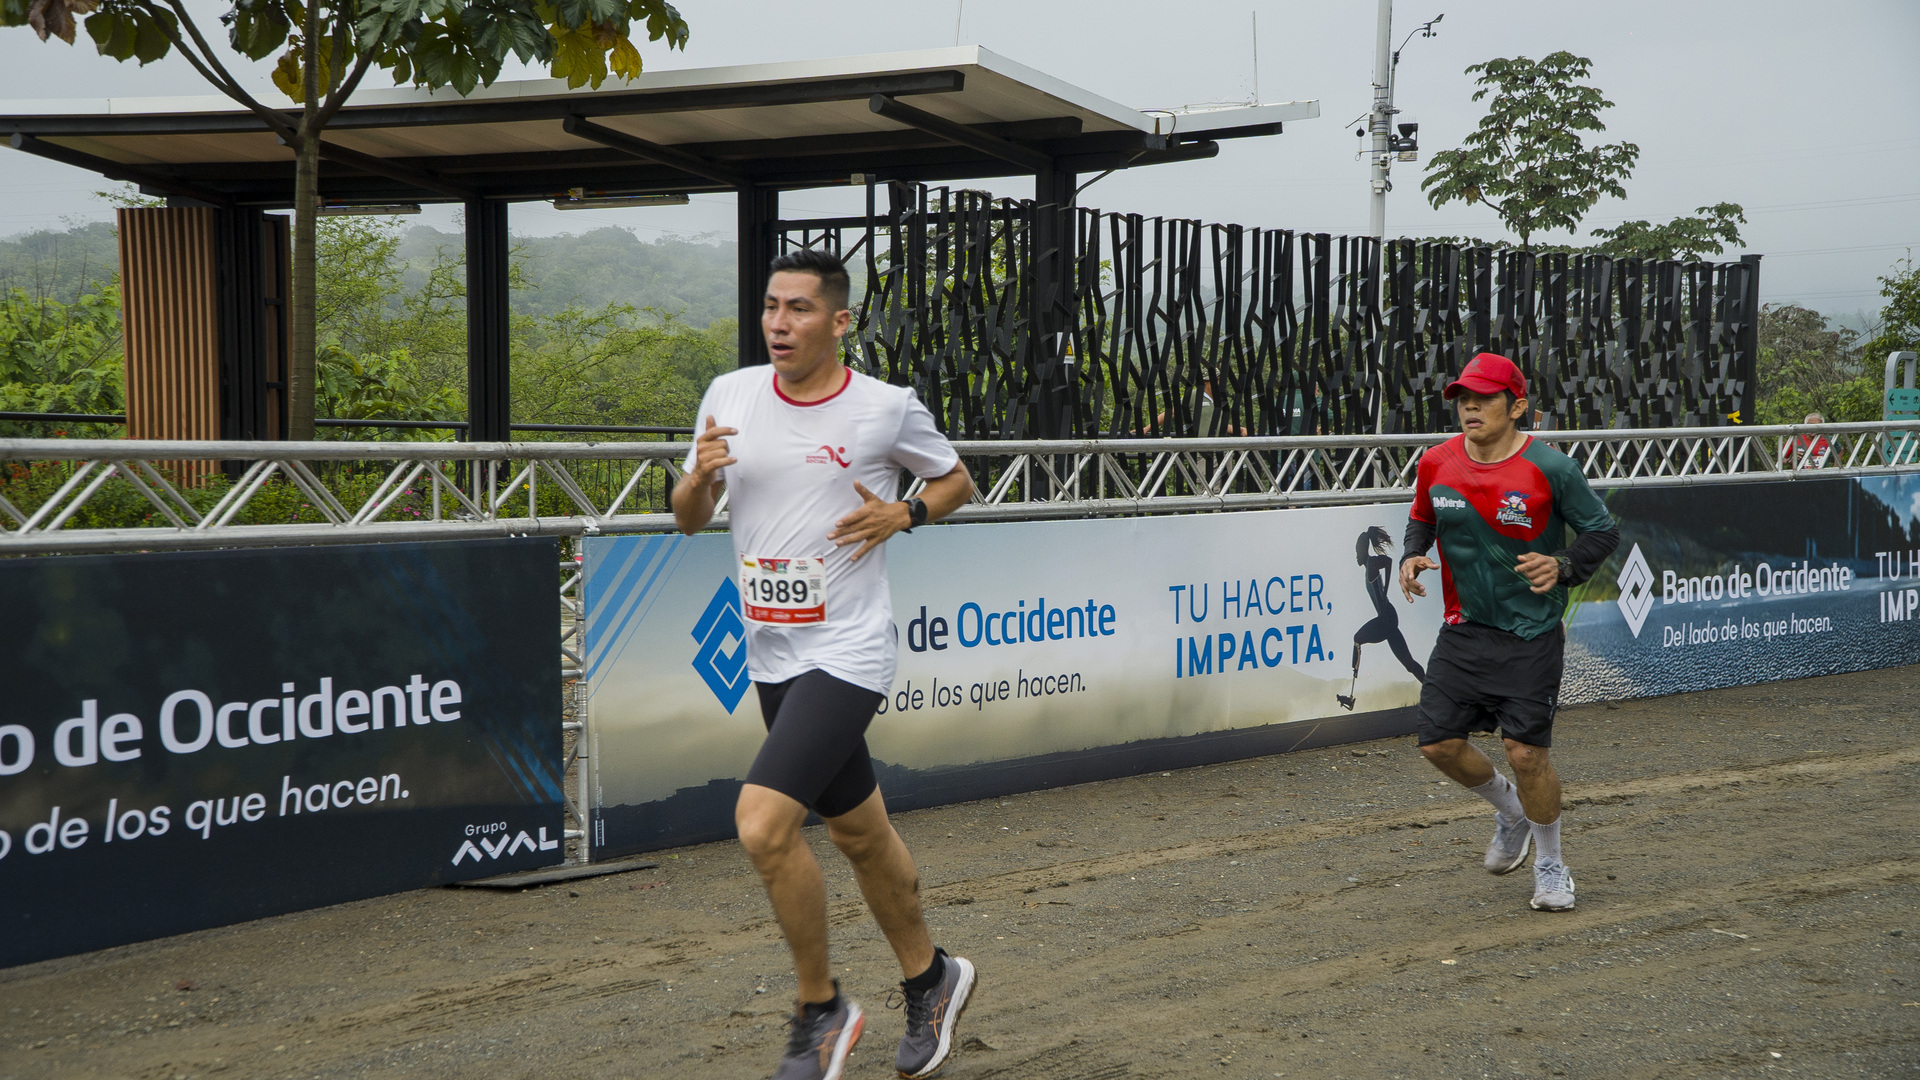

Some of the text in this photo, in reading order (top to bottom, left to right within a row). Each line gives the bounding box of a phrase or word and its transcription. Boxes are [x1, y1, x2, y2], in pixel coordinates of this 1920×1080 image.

[1663, 561, 1852, 605] Banco de Occidente
[1875, 551, 1901, 582] TU
[749, 577, 808, 604] 1989
[1169, 573, 1333, 625] TU HACER,
[1880, 589, 1920, 623] IMP
[907, 605, 949, 653] de
[956, 596, 1116, 648] Occidente
[1663, 612, 1833, 648] Del lado de los que hacen.
[1176, 623, 1335, 680] IMPACTA.
[895, 680, 924, 713] de
[930, 677, 963, 709] los
[969, 679, 1010, 713] que
[1016, 667, 1087, 699] hacen.
[54, 699, 143, 768] de
[159, 674, 462, 755] Occidente
[25, 806, 89, 855] de
[104, 797, 171, 843] los
[185, 791, 267, 840] que
[279, 773, 410, 817] hacen.
[464, 821, 508, 836] Grupo
[451, 826, 559, 867] AVAL
